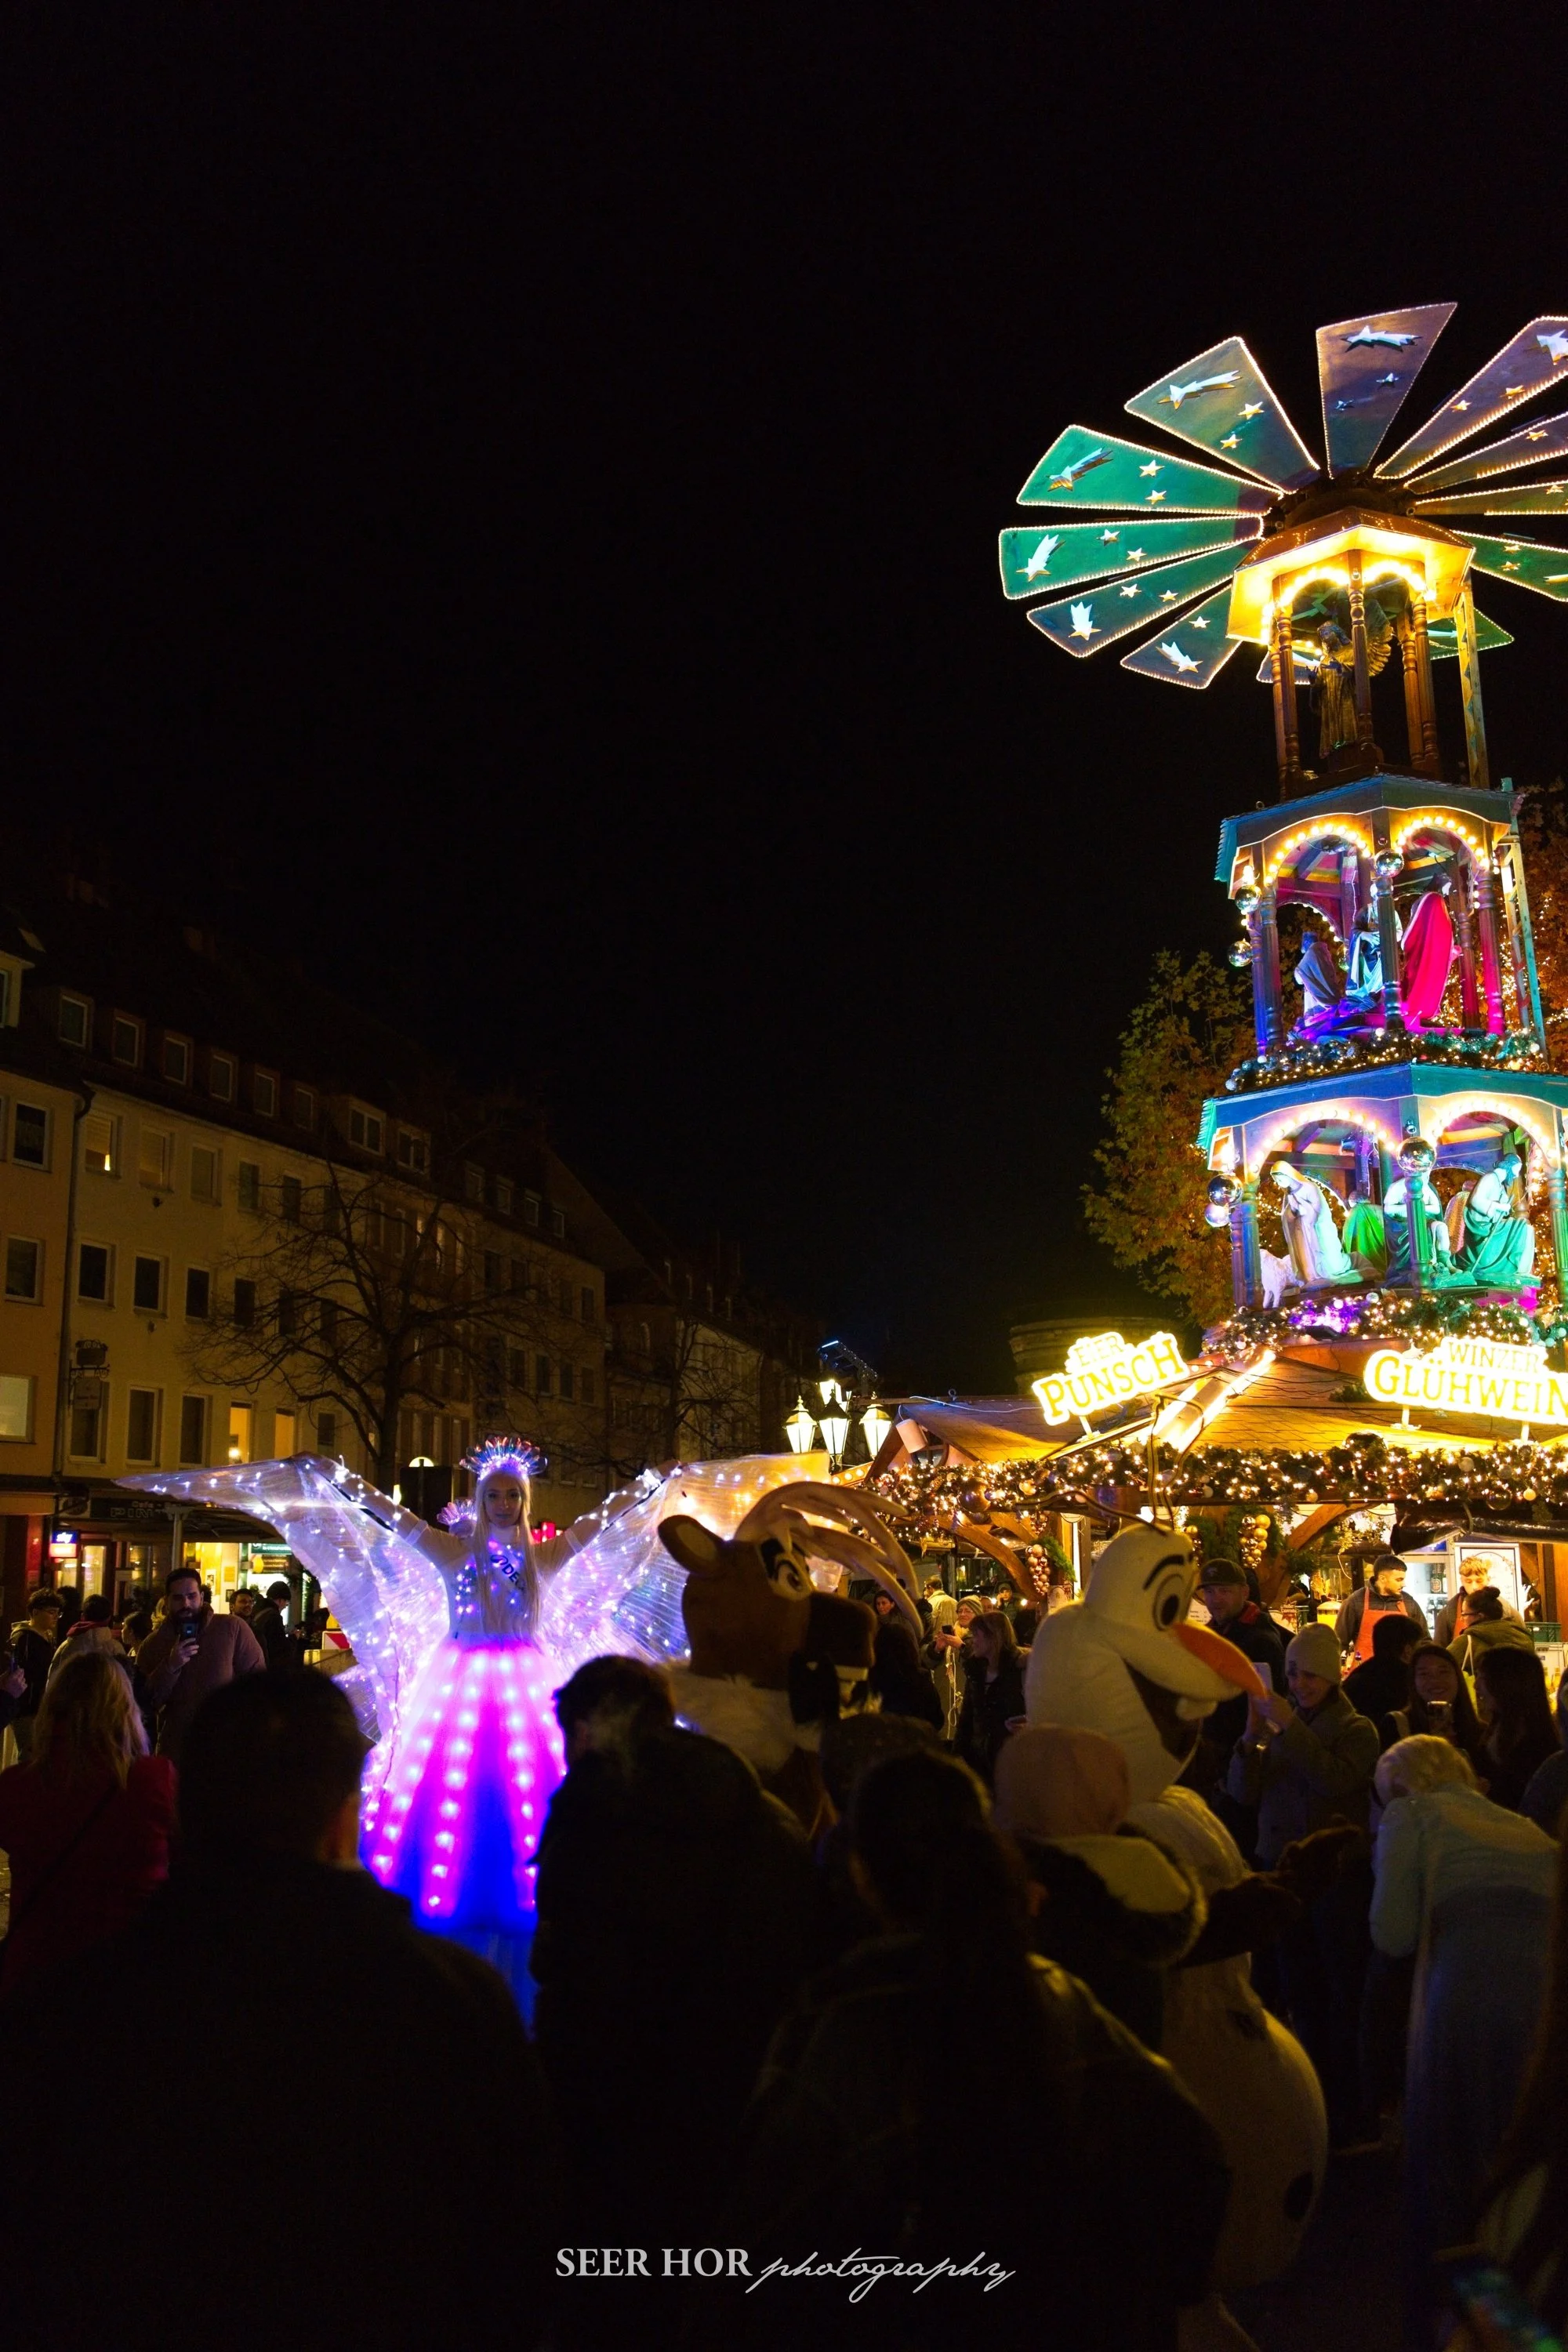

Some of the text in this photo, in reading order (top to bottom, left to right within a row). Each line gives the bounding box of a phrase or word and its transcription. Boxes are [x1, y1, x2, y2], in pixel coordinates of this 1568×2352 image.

[1074, 1335, 1124, 1367] EIER
[1449, 1341, 1540, 1373] WINZER
[1040, 1339, 1184, 1417] PUNSCH
